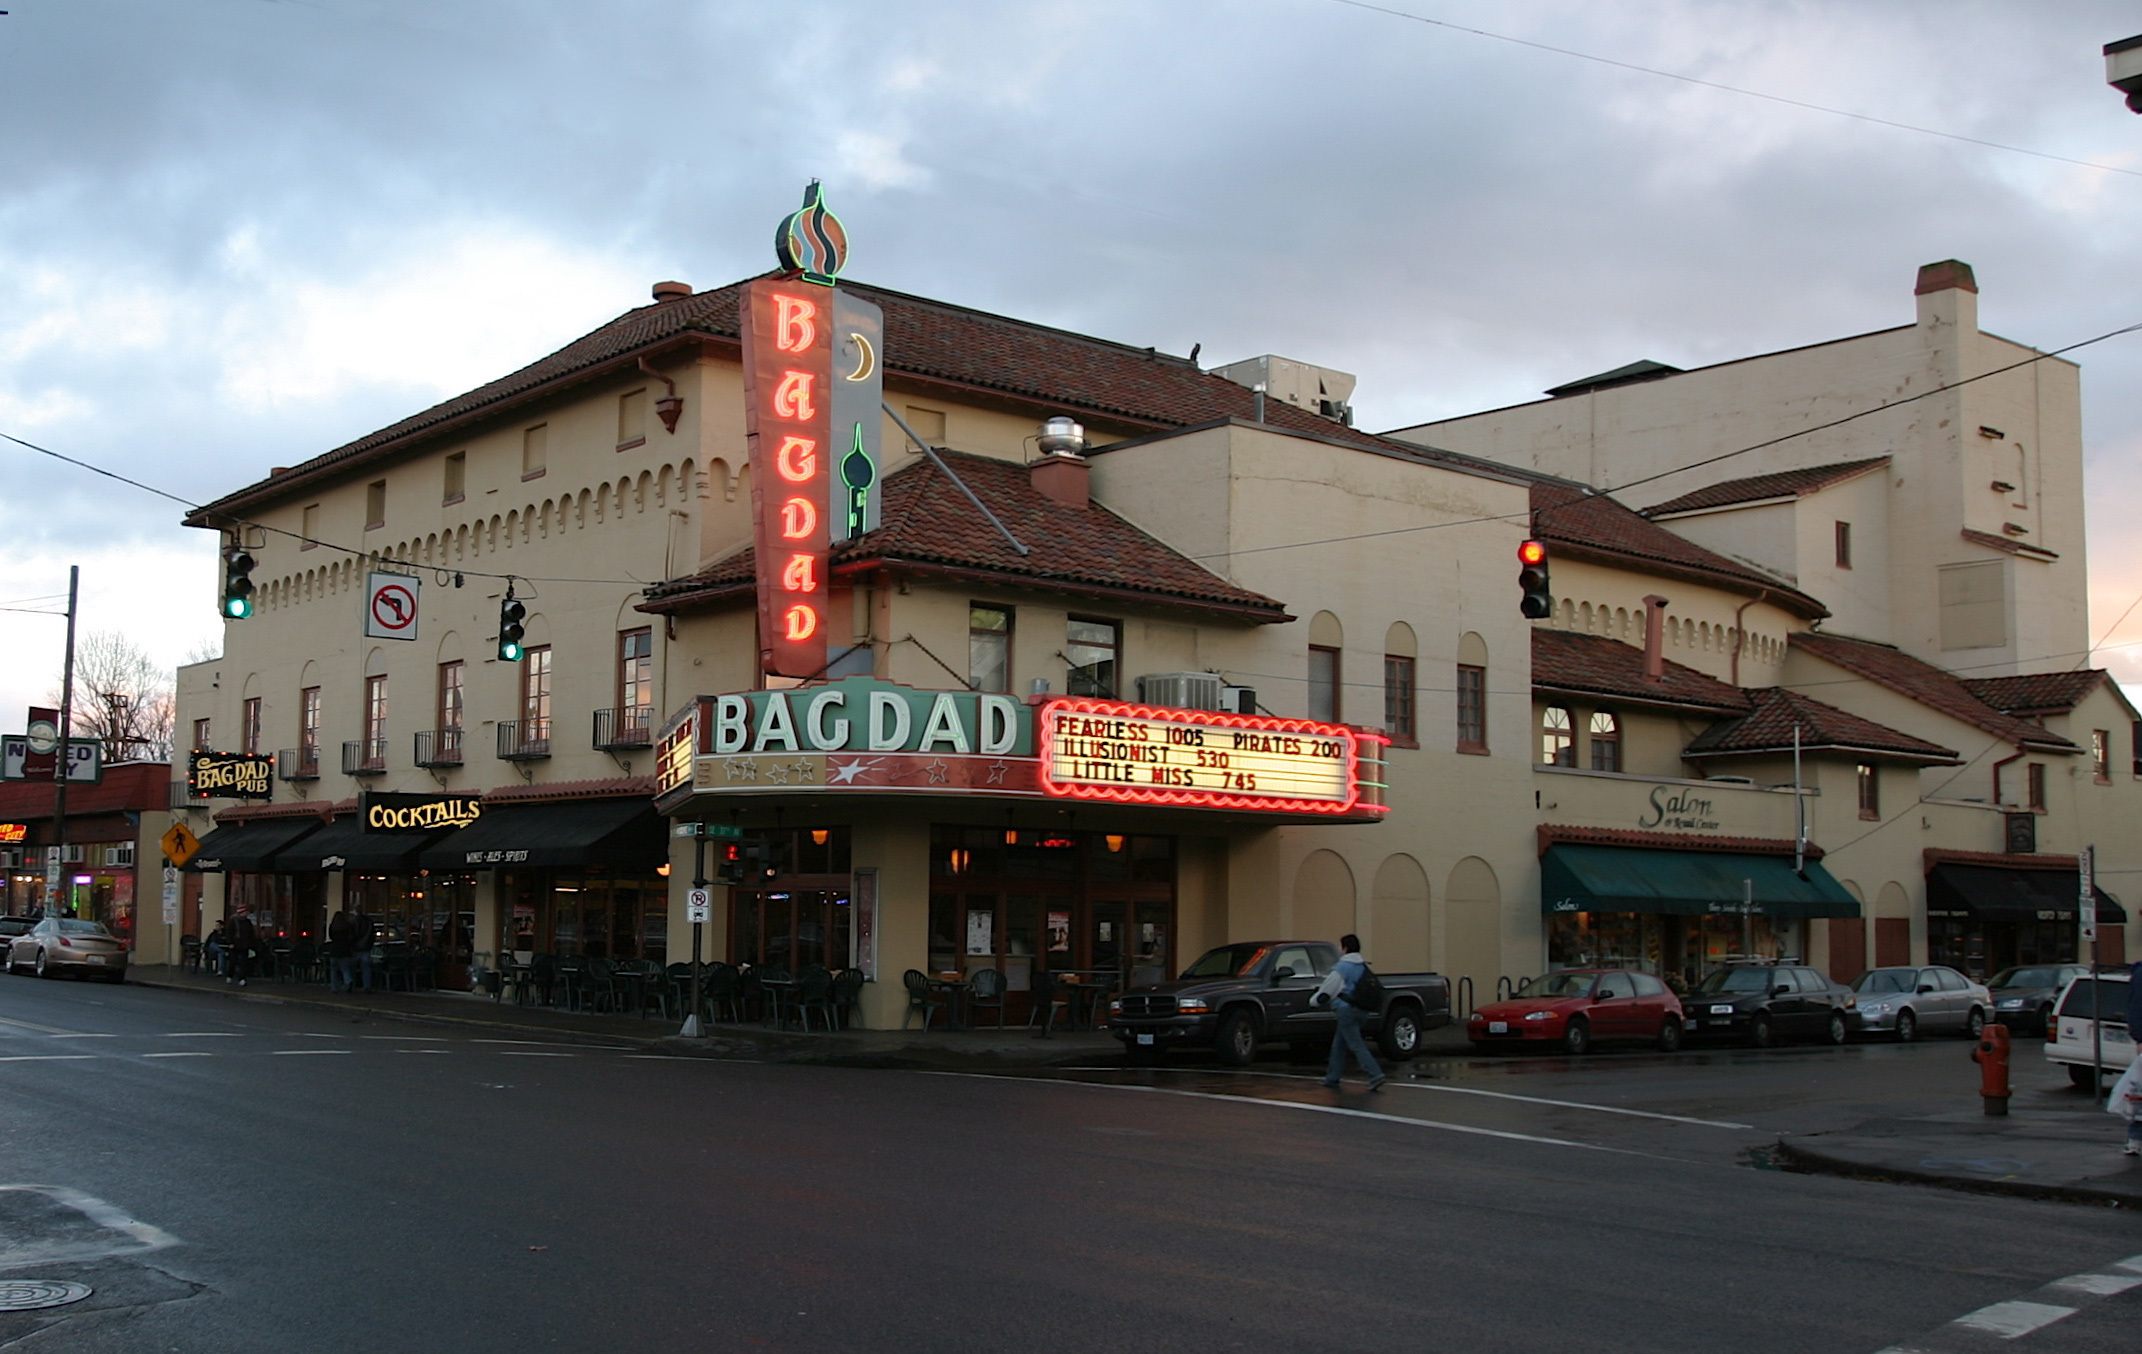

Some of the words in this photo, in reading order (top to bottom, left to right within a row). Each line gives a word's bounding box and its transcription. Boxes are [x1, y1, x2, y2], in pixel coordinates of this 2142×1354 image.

[772, 294, 817, 641] BAGDAD
[716, 691, 1018, 755] BAGDAD
[1057, 715, 1148, 742] FEARLESS
[1166, 726, 1204, 746] 1005
[1233, 732, 1302, 756] PIRATES
[1311, 740, 1342, 759] 200
[1064, 738, 1169, 764] ILLUSIONIST
[1196, 749, 1229, 769] 530
[197, 761, 270, 789] BAGDAD
[236, 780, 268, 792] PUB
[1072, 760, 1134, 782] LITTLE
[1151, 766, 1194, 787] MISS
[1221, 771, 1256, 791] 745
[369, 800, 480, 828] COCKTAILS
[1639, 785, 1713, 828] Salon
